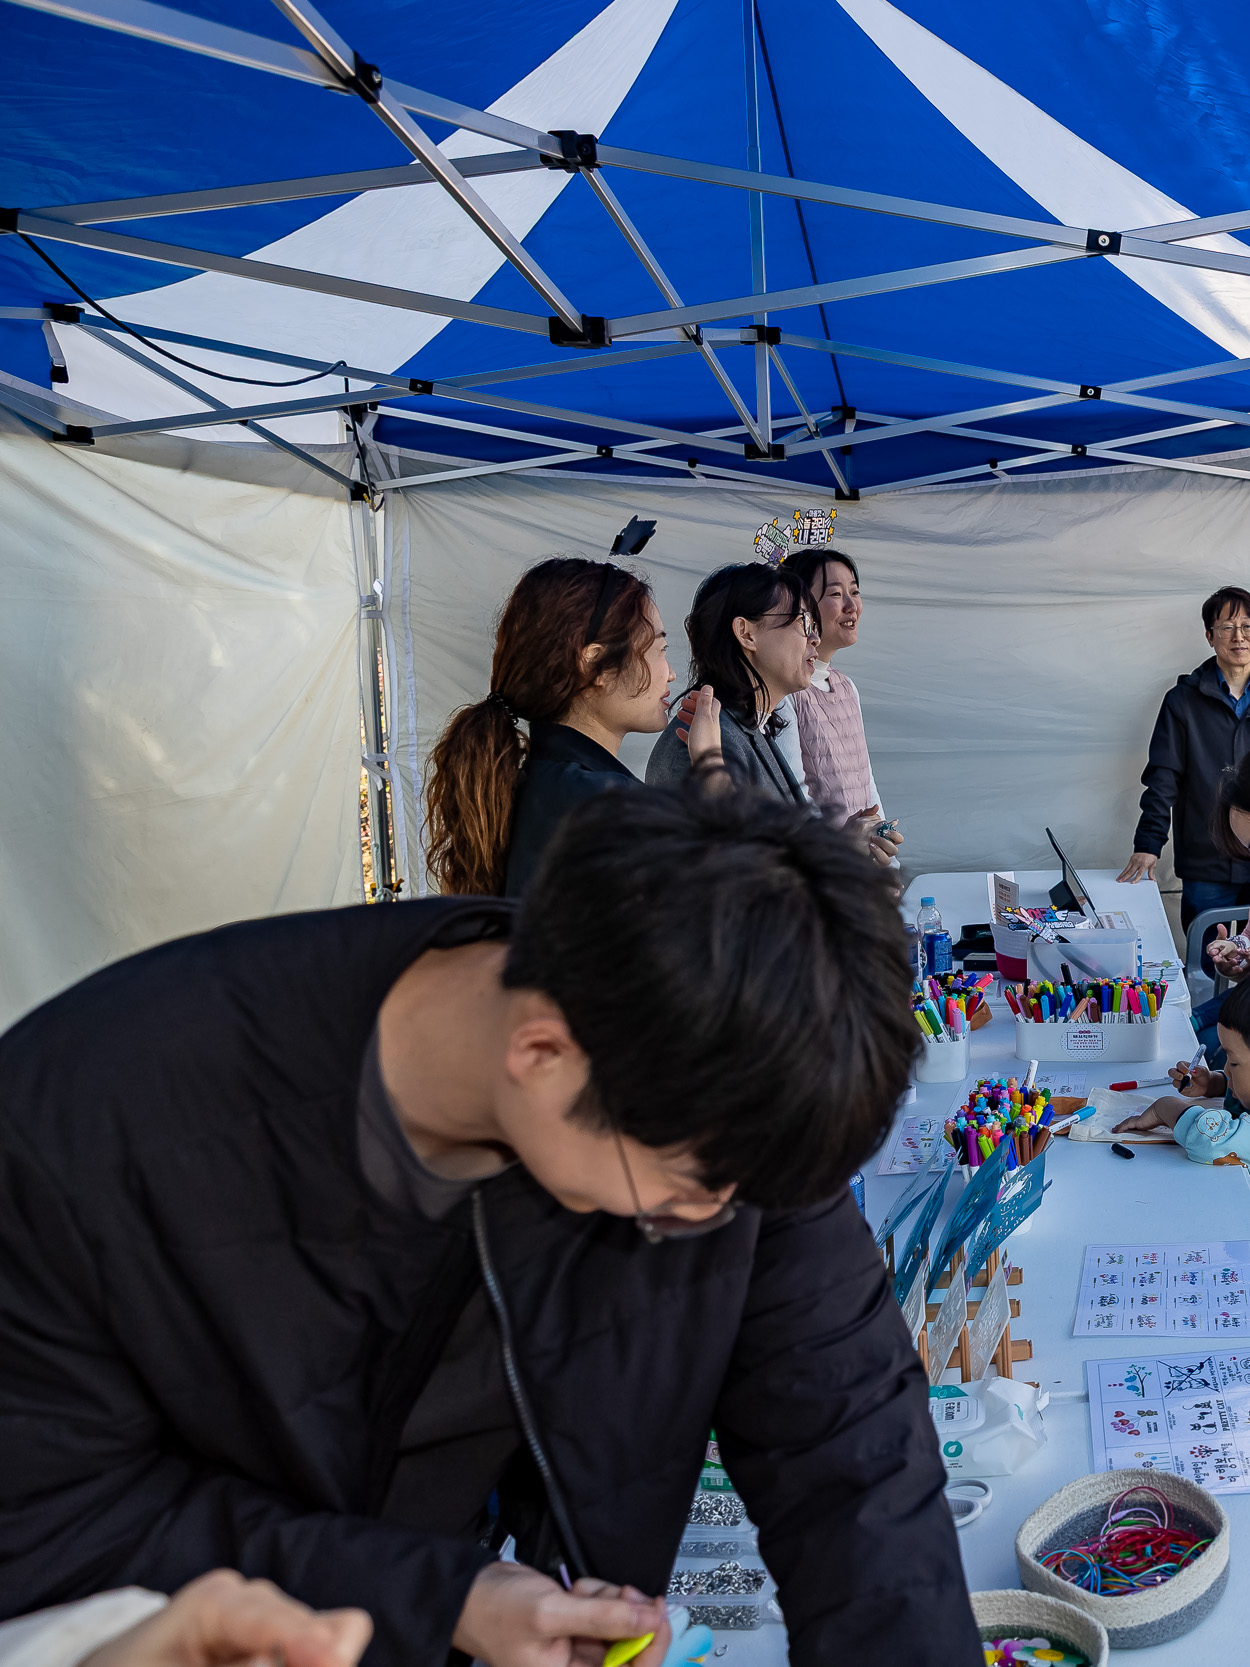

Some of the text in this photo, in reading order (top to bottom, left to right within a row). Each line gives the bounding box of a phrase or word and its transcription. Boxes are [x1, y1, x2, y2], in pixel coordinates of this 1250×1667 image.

[811, 517, 827, 530] 권리
[798, 529, 810, 545] 내
[810, 529, 829, 545] 권리
[1215, 1399, 1231, 1432] PRETTY CAT
[1192, 1461, 1209, 1486] 매일매일
[1214, 1457, 1237, 1475] 행복
[1227, 1475, 1240, 1483] 더
